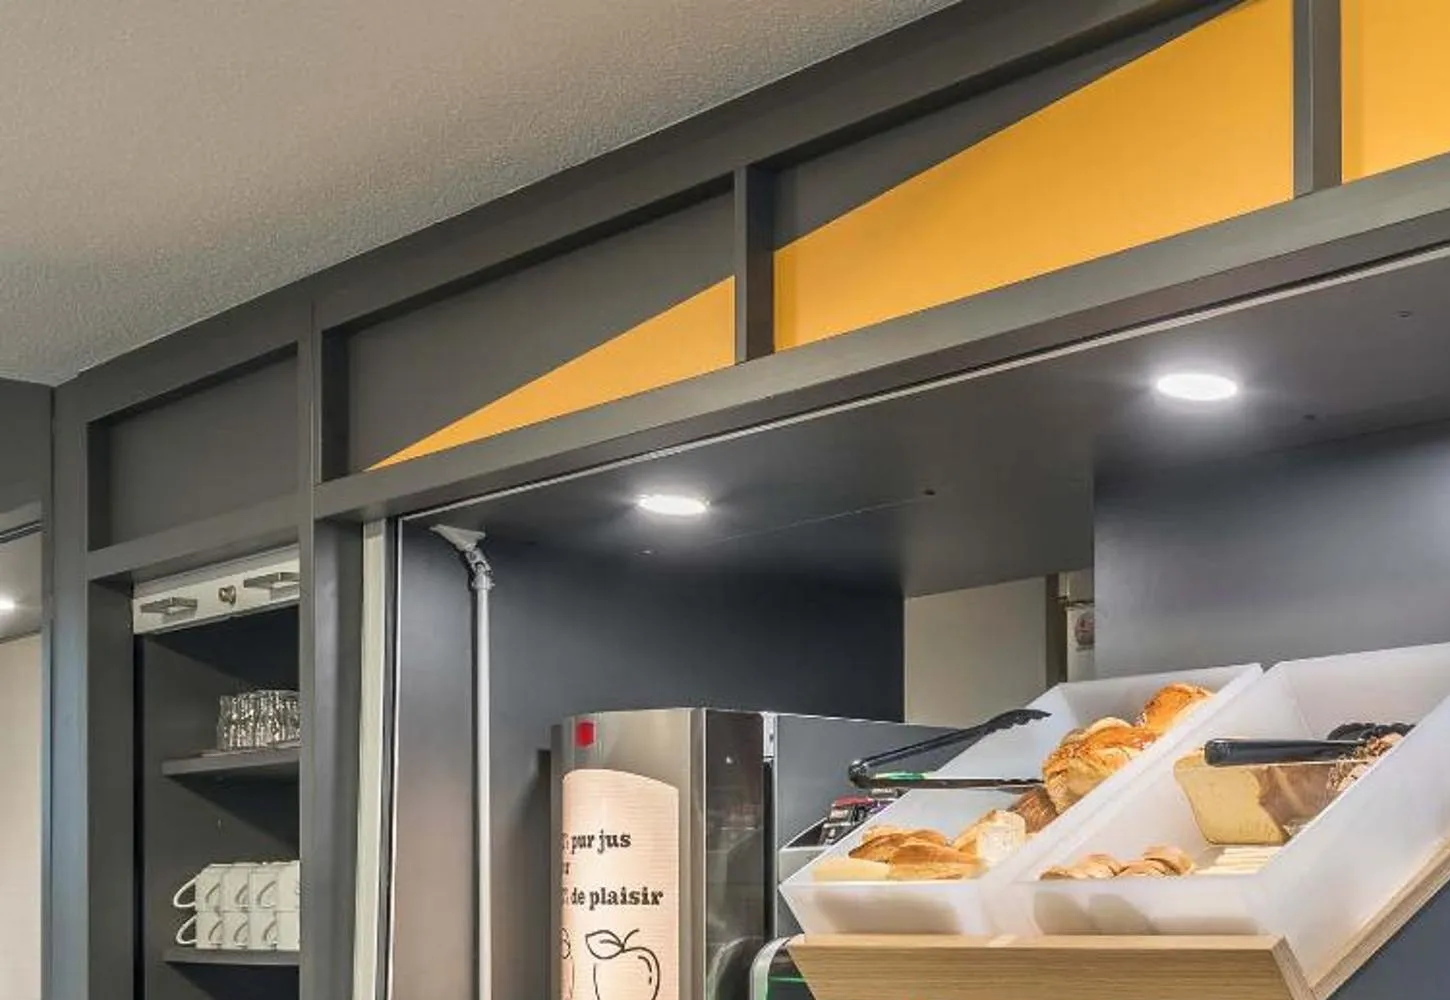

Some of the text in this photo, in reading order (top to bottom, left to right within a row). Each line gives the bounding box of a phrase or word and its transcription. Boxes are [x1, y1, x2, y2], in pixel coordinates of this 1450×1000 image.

[571, 834, 596, 856] pur
[597, 829, 632, 855] jus
[571, 887, 585, 905] de
[588, 886, 664, 911] plaisir
